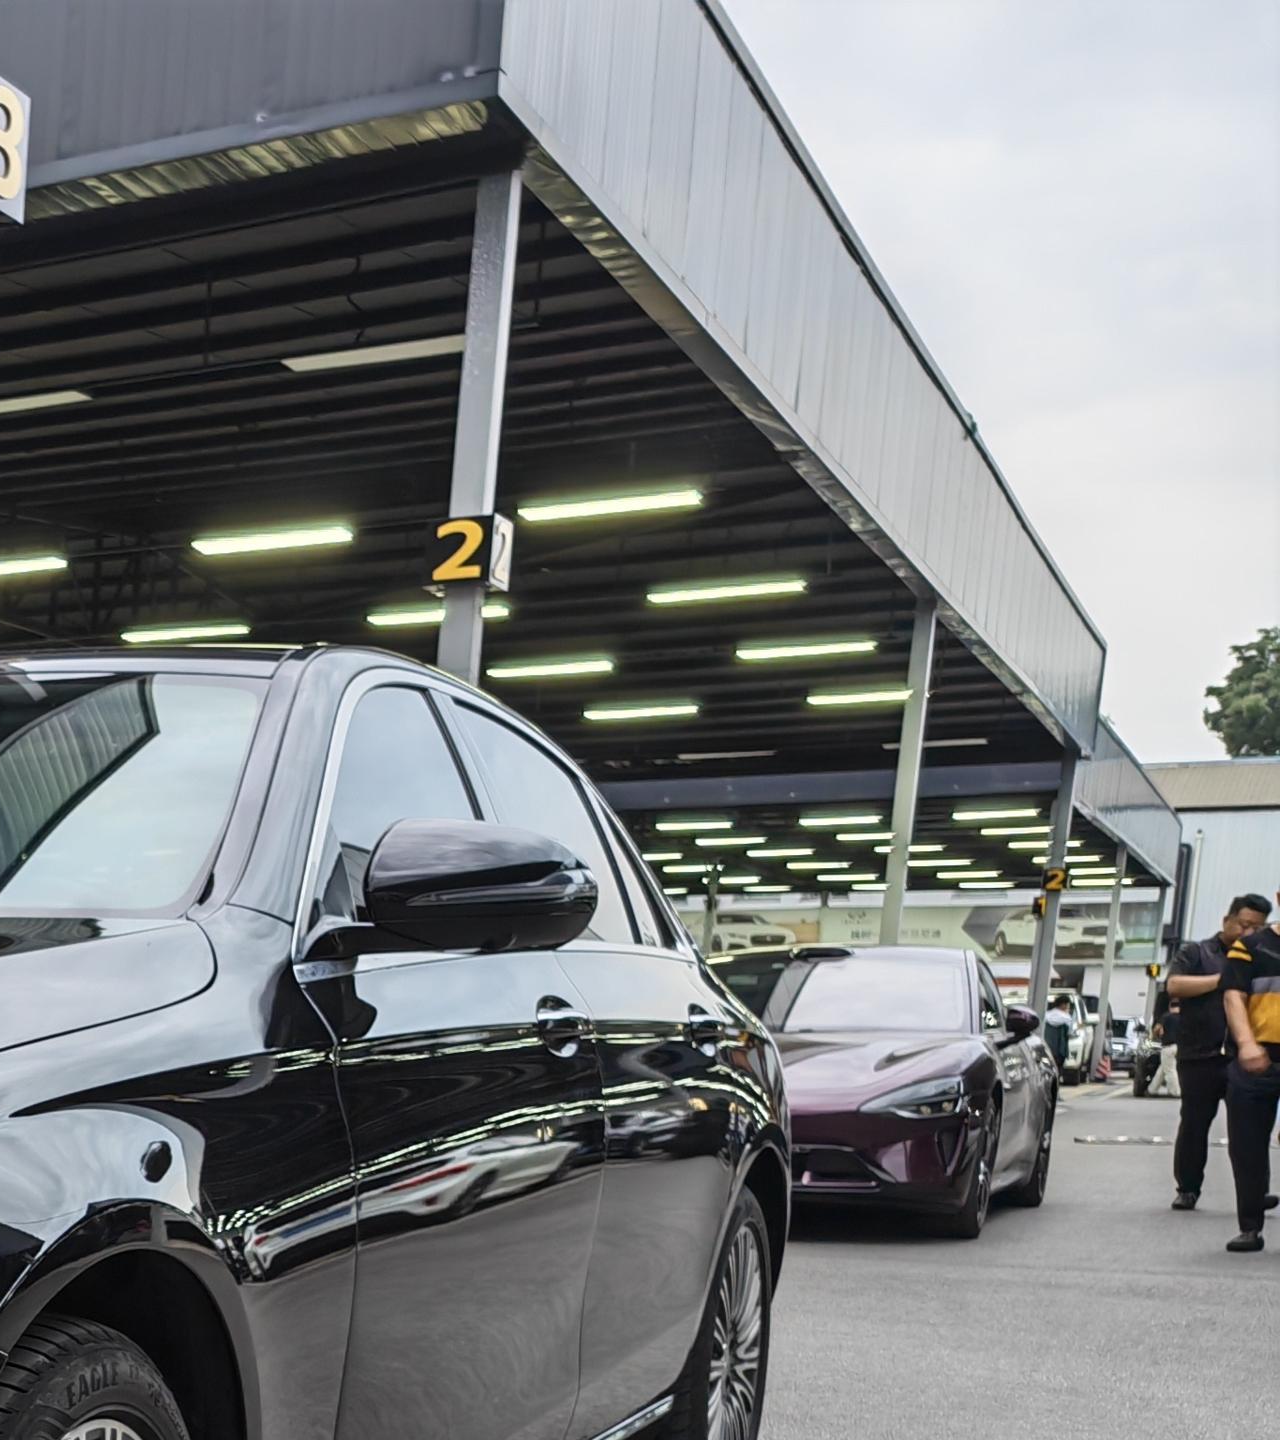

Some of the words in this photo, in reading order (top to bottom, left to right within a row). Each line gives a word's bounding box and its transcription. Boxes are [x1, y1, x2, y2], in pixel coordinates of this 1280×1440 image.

[431, 518, 484, 582] 2
[491, 520, 511, 585] 2
[1045, 869, 1066, 890] 2
[65, 1359, 119, 1410] EAGLE
